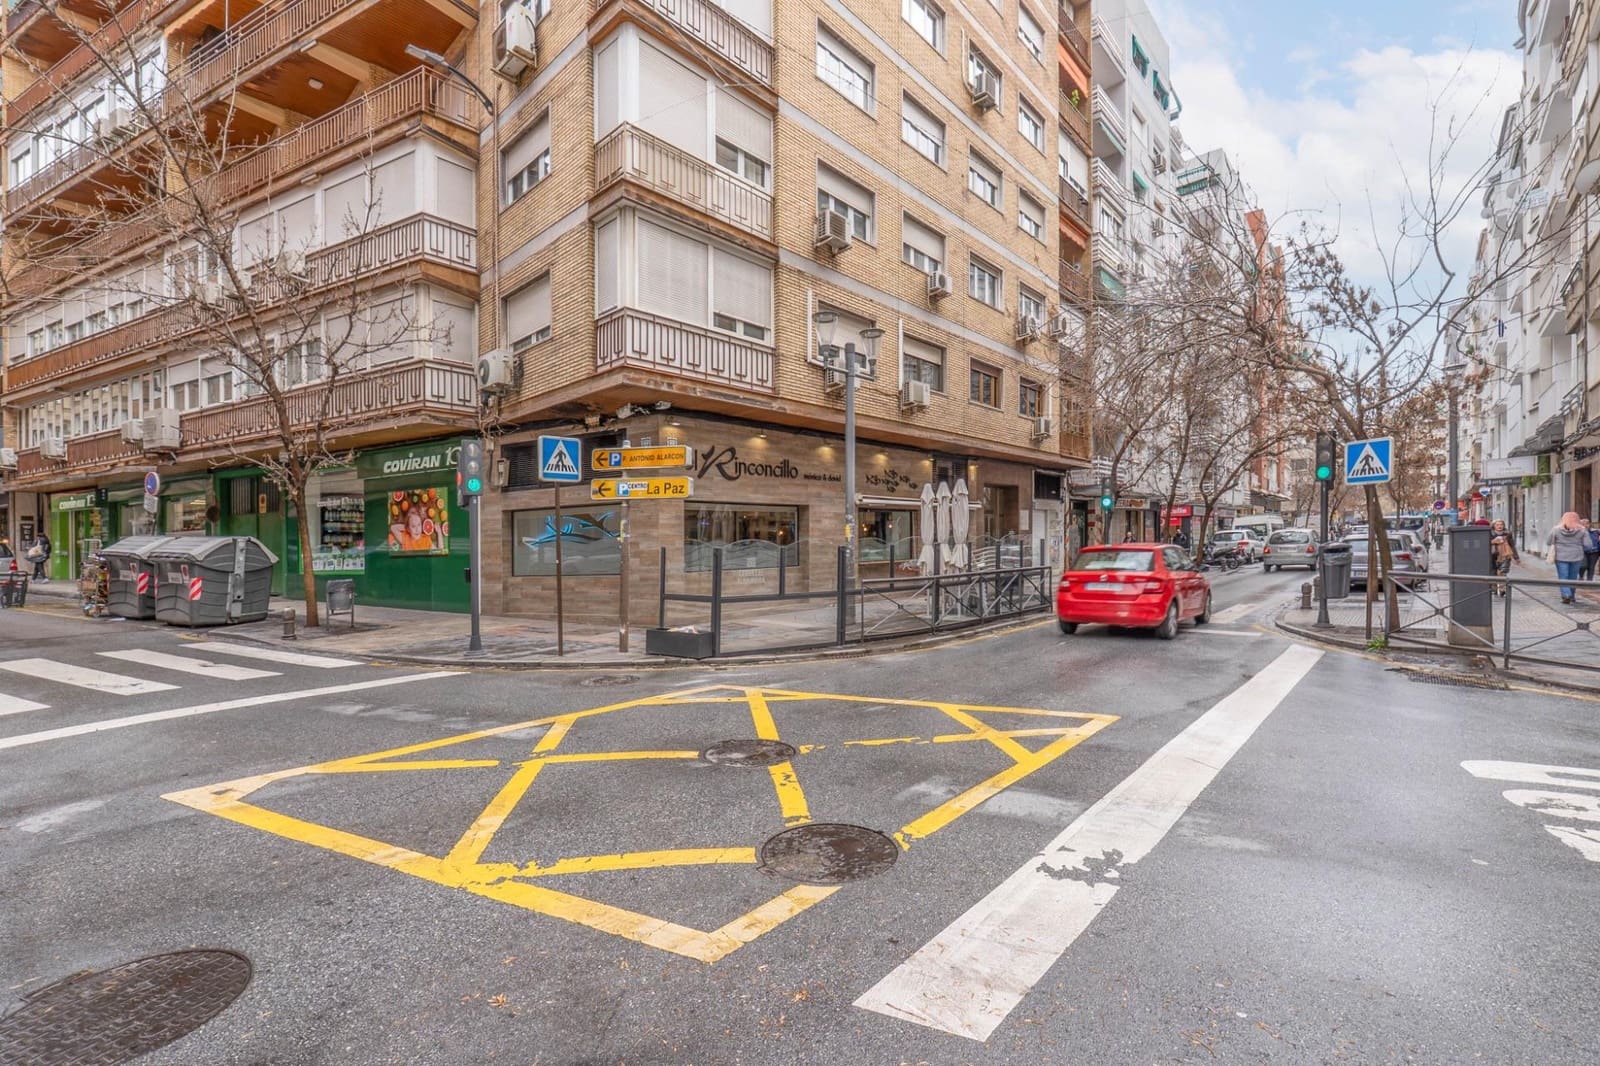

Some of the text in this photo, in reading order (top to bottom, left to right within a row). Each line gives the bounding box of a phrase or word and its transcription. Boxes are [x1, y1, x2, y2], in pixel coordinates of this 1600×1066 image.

[629, 454, 655, 462] ANTONIO
[697, 445, 799, 481] Rinconcillo
[647, 482, 685, 495] La Paz
